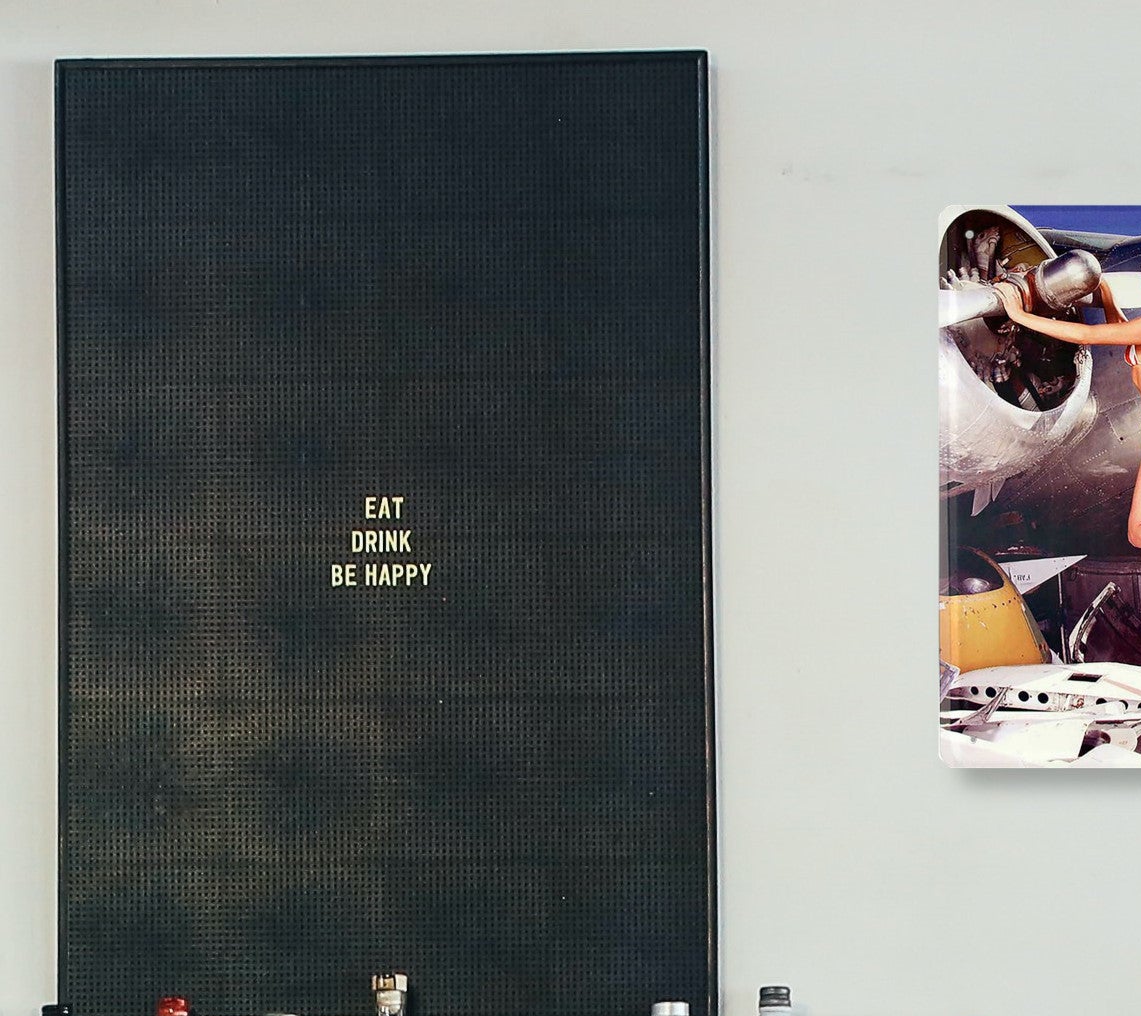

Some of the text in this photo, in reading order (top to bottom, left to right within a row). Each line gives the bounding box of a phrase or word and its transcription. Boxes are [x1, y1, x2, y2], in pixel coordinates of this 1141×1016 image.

[365, 496, 404, 520] EAT
[351, 529, 412, 553] DRINK
[331, 563, 432, 587] BE HAPPY
